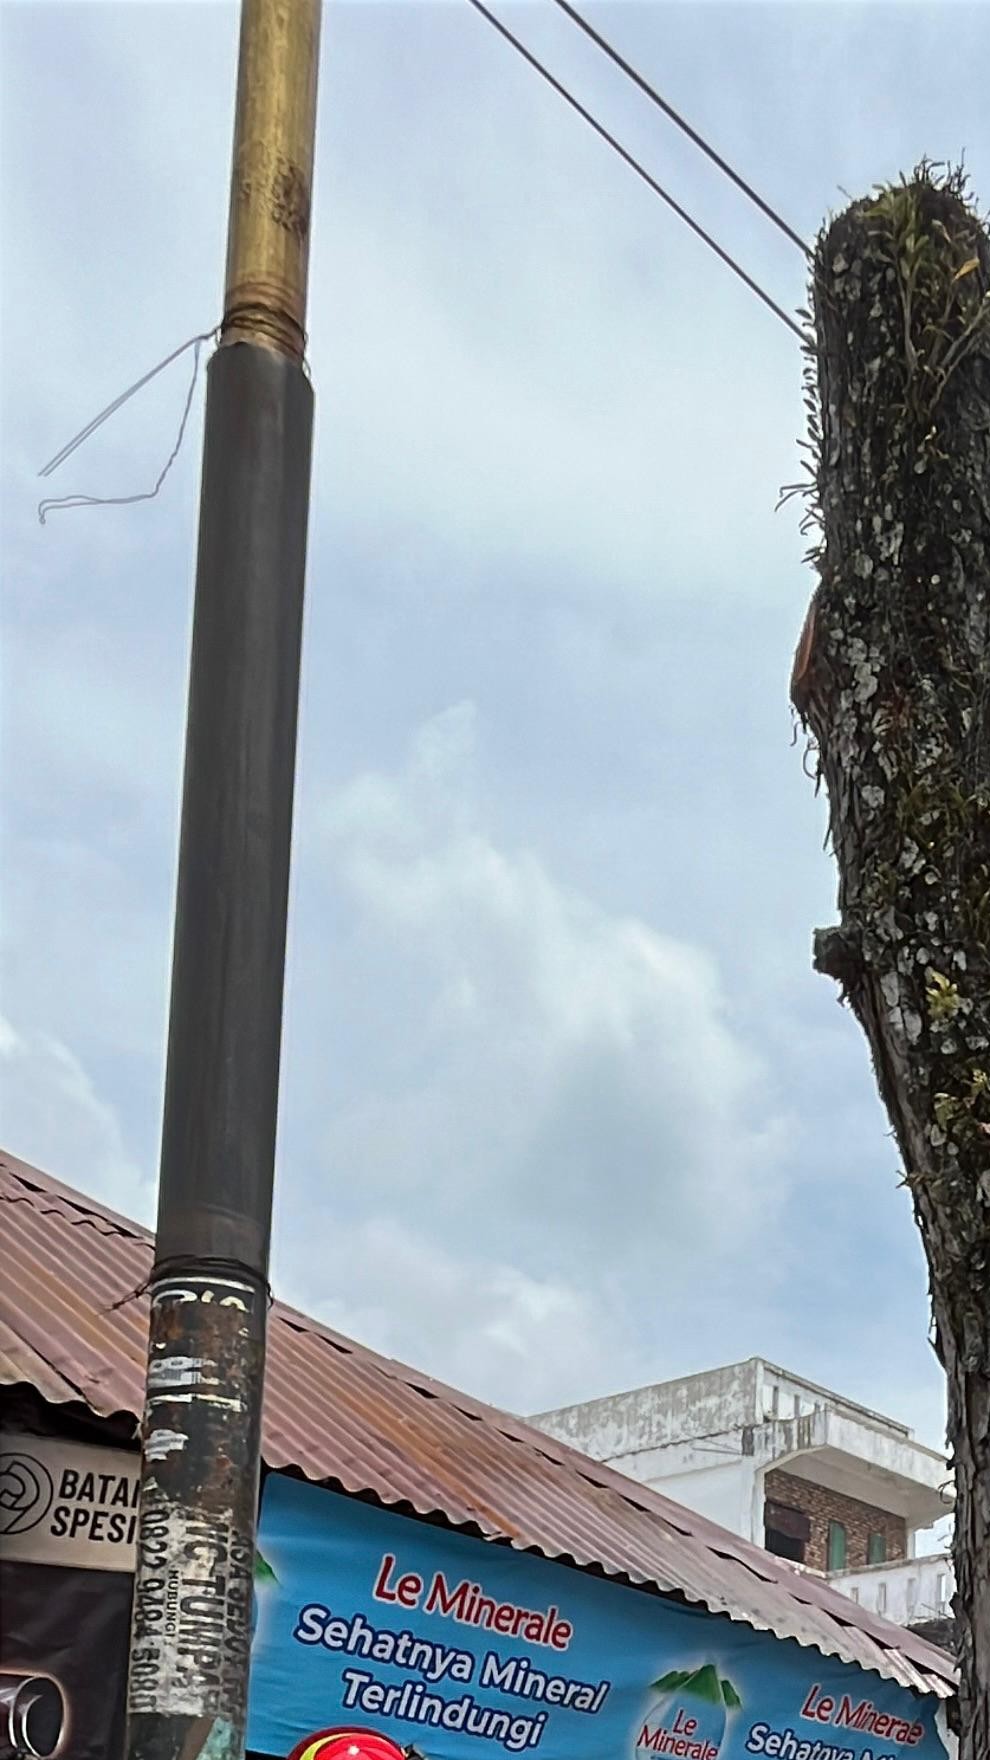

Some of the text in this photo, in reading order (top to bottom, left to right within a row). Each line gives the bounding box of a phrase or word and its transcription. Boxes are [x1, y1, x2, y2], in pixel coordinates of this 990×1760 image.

[374, 1554, 572, 1650] Le Minerale
[295, 1604, 610, 1712] Sehatnya Mineral
[343, 1669, 548, 1751] Terlindungi
[673, 1709, 697, 1736] Le
[802, 1684, 834, 1722] Le
